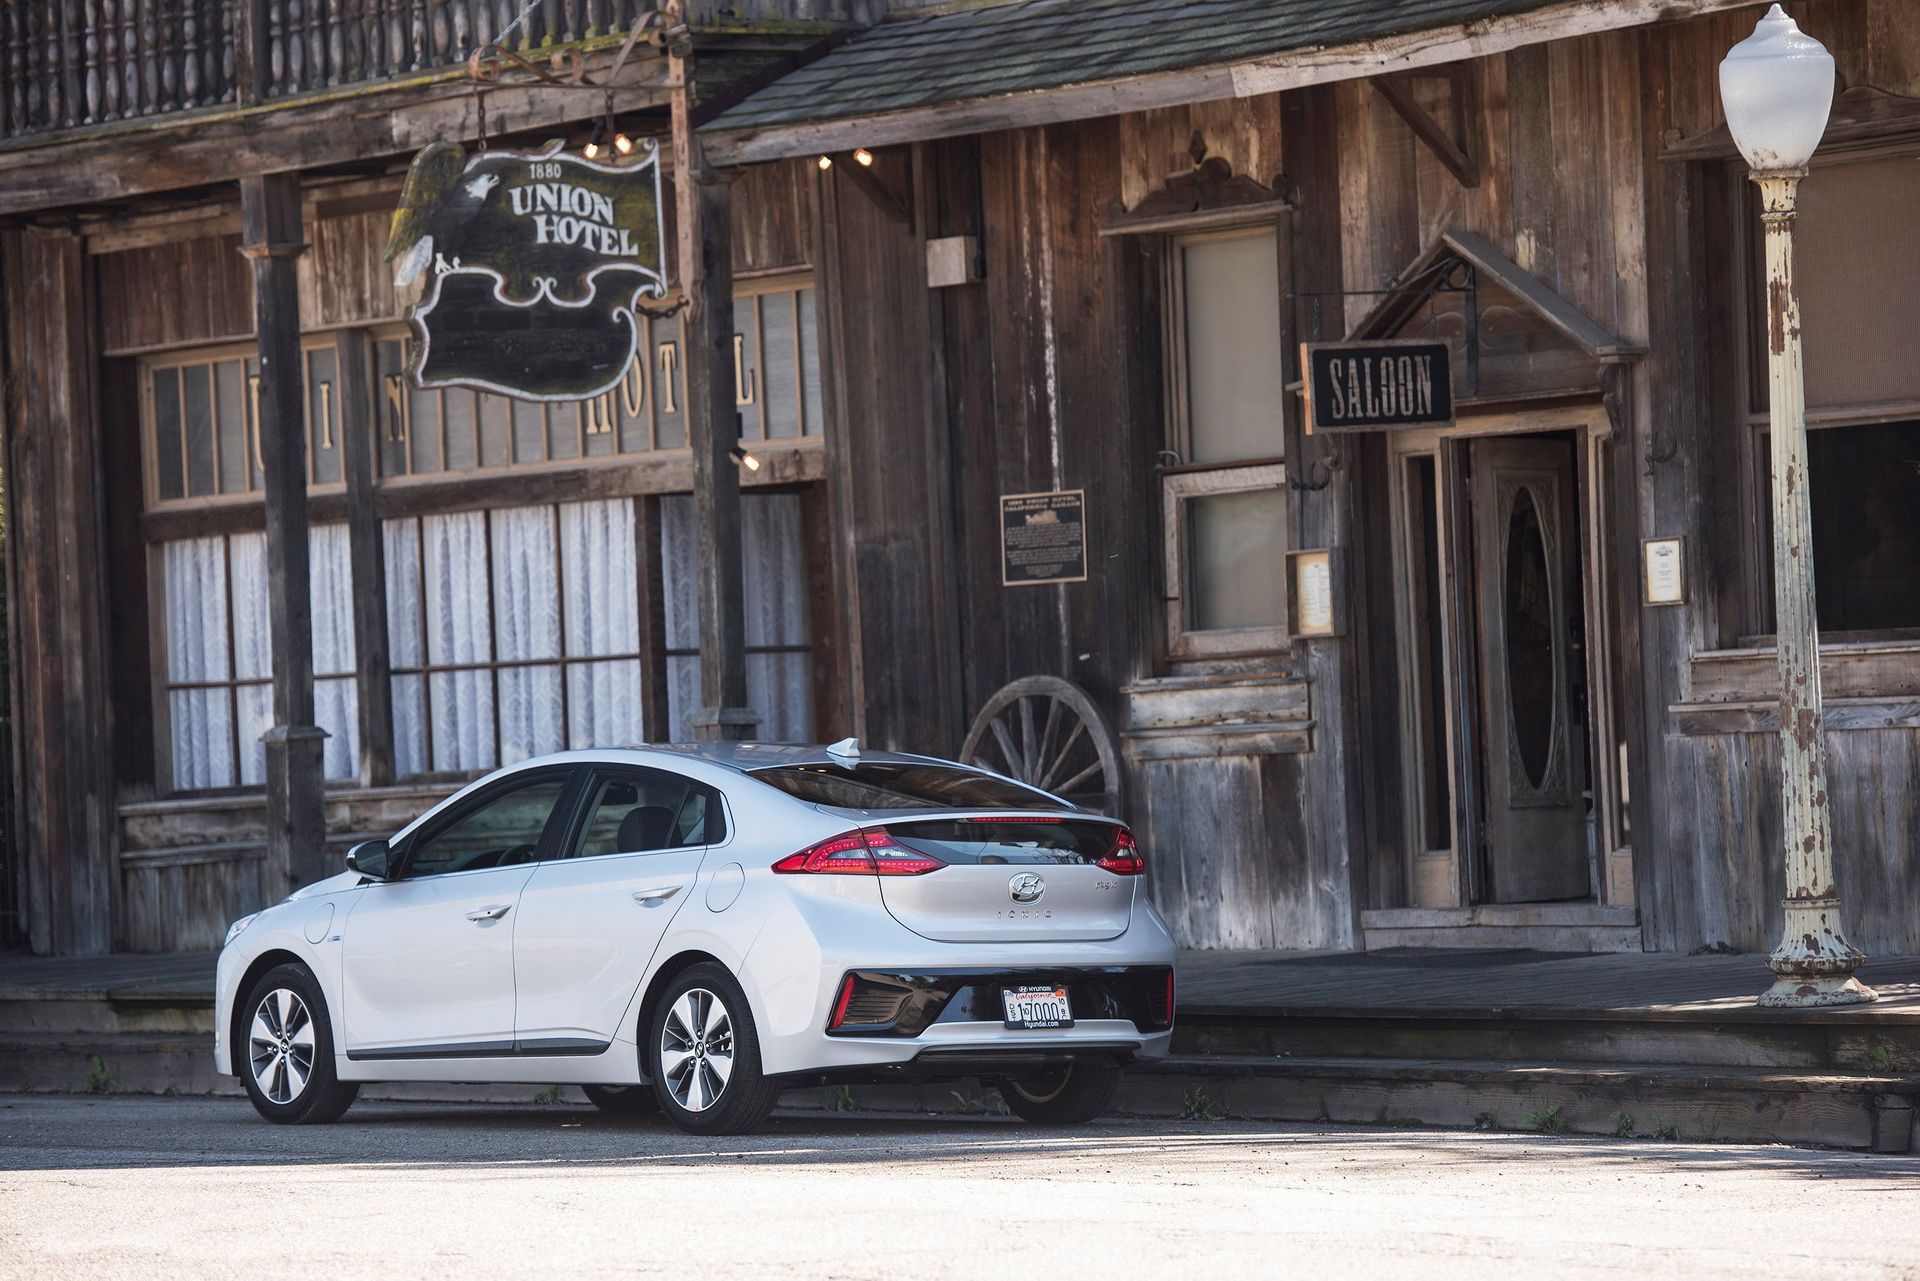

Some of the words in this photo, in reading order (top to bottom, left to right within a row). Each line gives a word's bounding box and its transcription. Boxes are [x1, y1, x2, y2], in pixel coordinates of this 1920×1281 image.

[529, 163, 562, 179] 1880
[508, 183, 613, 225] UNION
[532, 215, 639, 256] HOTEL
[1329, 355, 1432, 419] SALOON
[1015, 993, 1054, 1002] California
